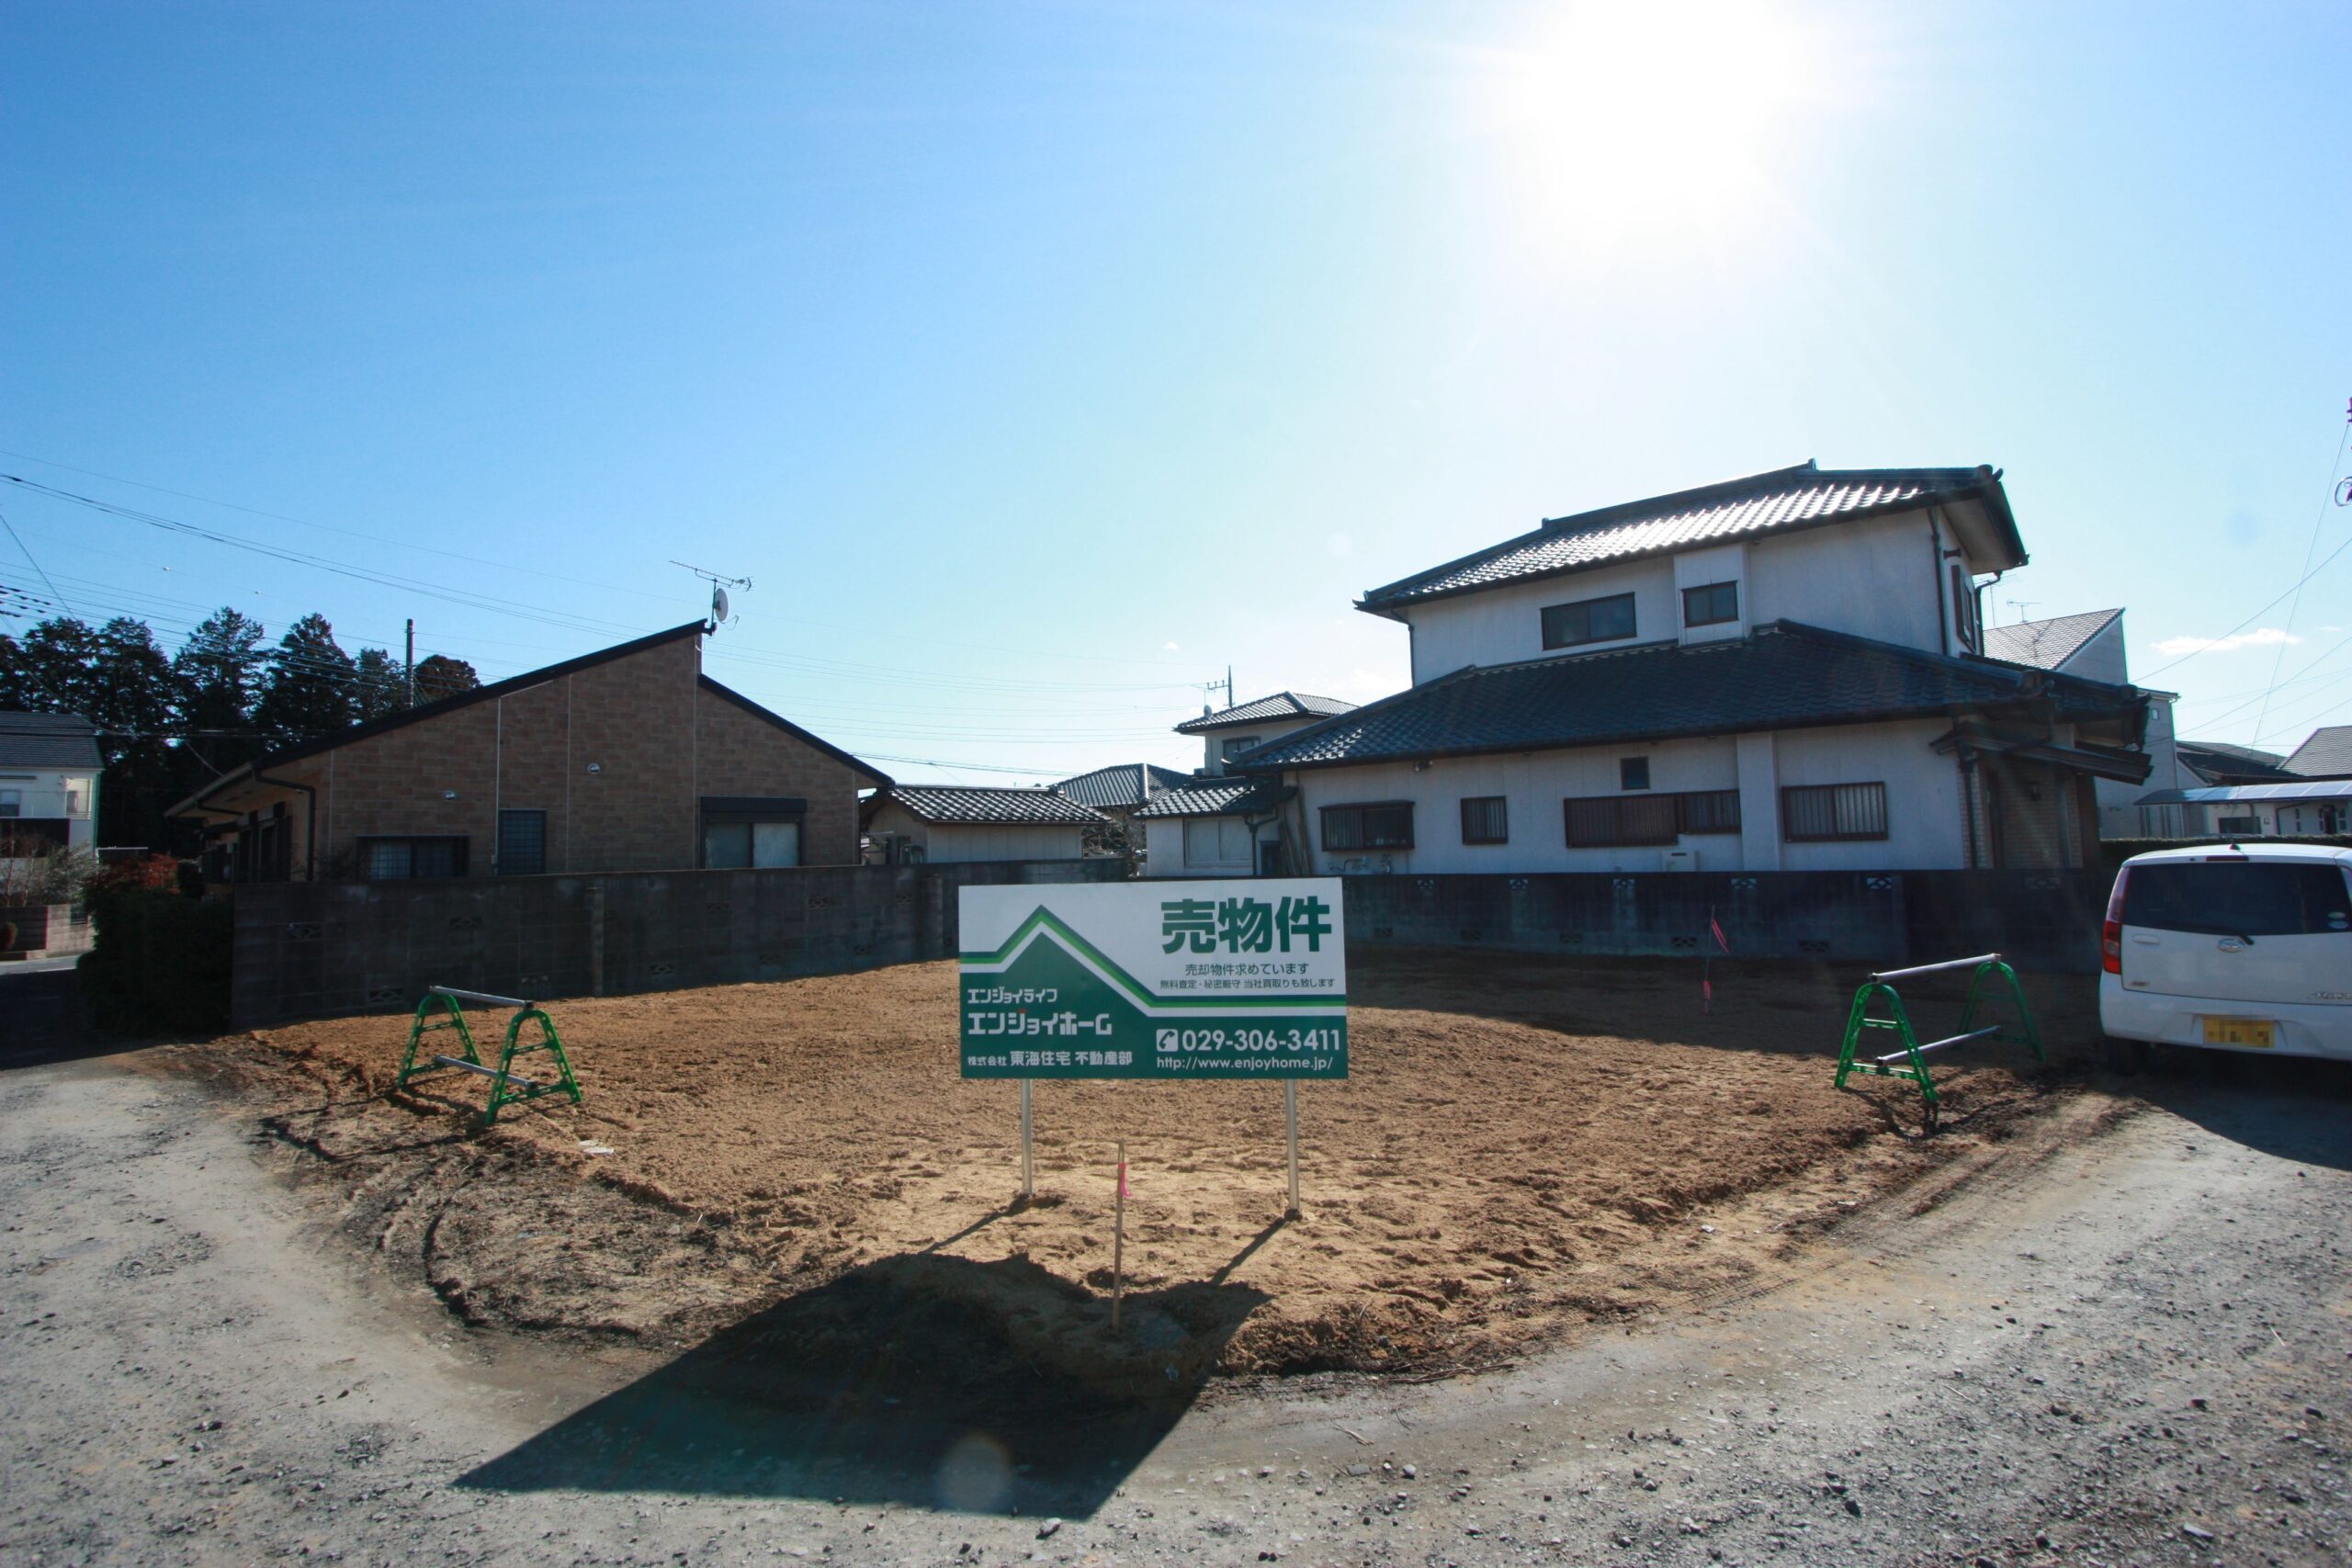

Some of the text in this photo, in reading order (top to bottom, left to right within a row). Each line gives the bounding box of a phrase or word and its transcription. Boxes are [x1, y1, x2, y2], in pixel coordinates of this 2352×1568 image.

[1161, 897, 1331, 953] 売物件
[1185, 962, 1309, 976] 売却物件求めています
[1245, 978, 1334, 989] 当社買取りも致します
[967, 987, 1057, 1004] エンジョイライフ
[967, 1010, 1113, 1035] エンジョイホーム
[1182, 1029, 1340, 1051] 029-306-3411
[967, 1051, 1133, 1066] 株式会社 東海住宅 不動産部
[1157, 1056, 1333, 1071] http://www.enjoyhome.jp/
